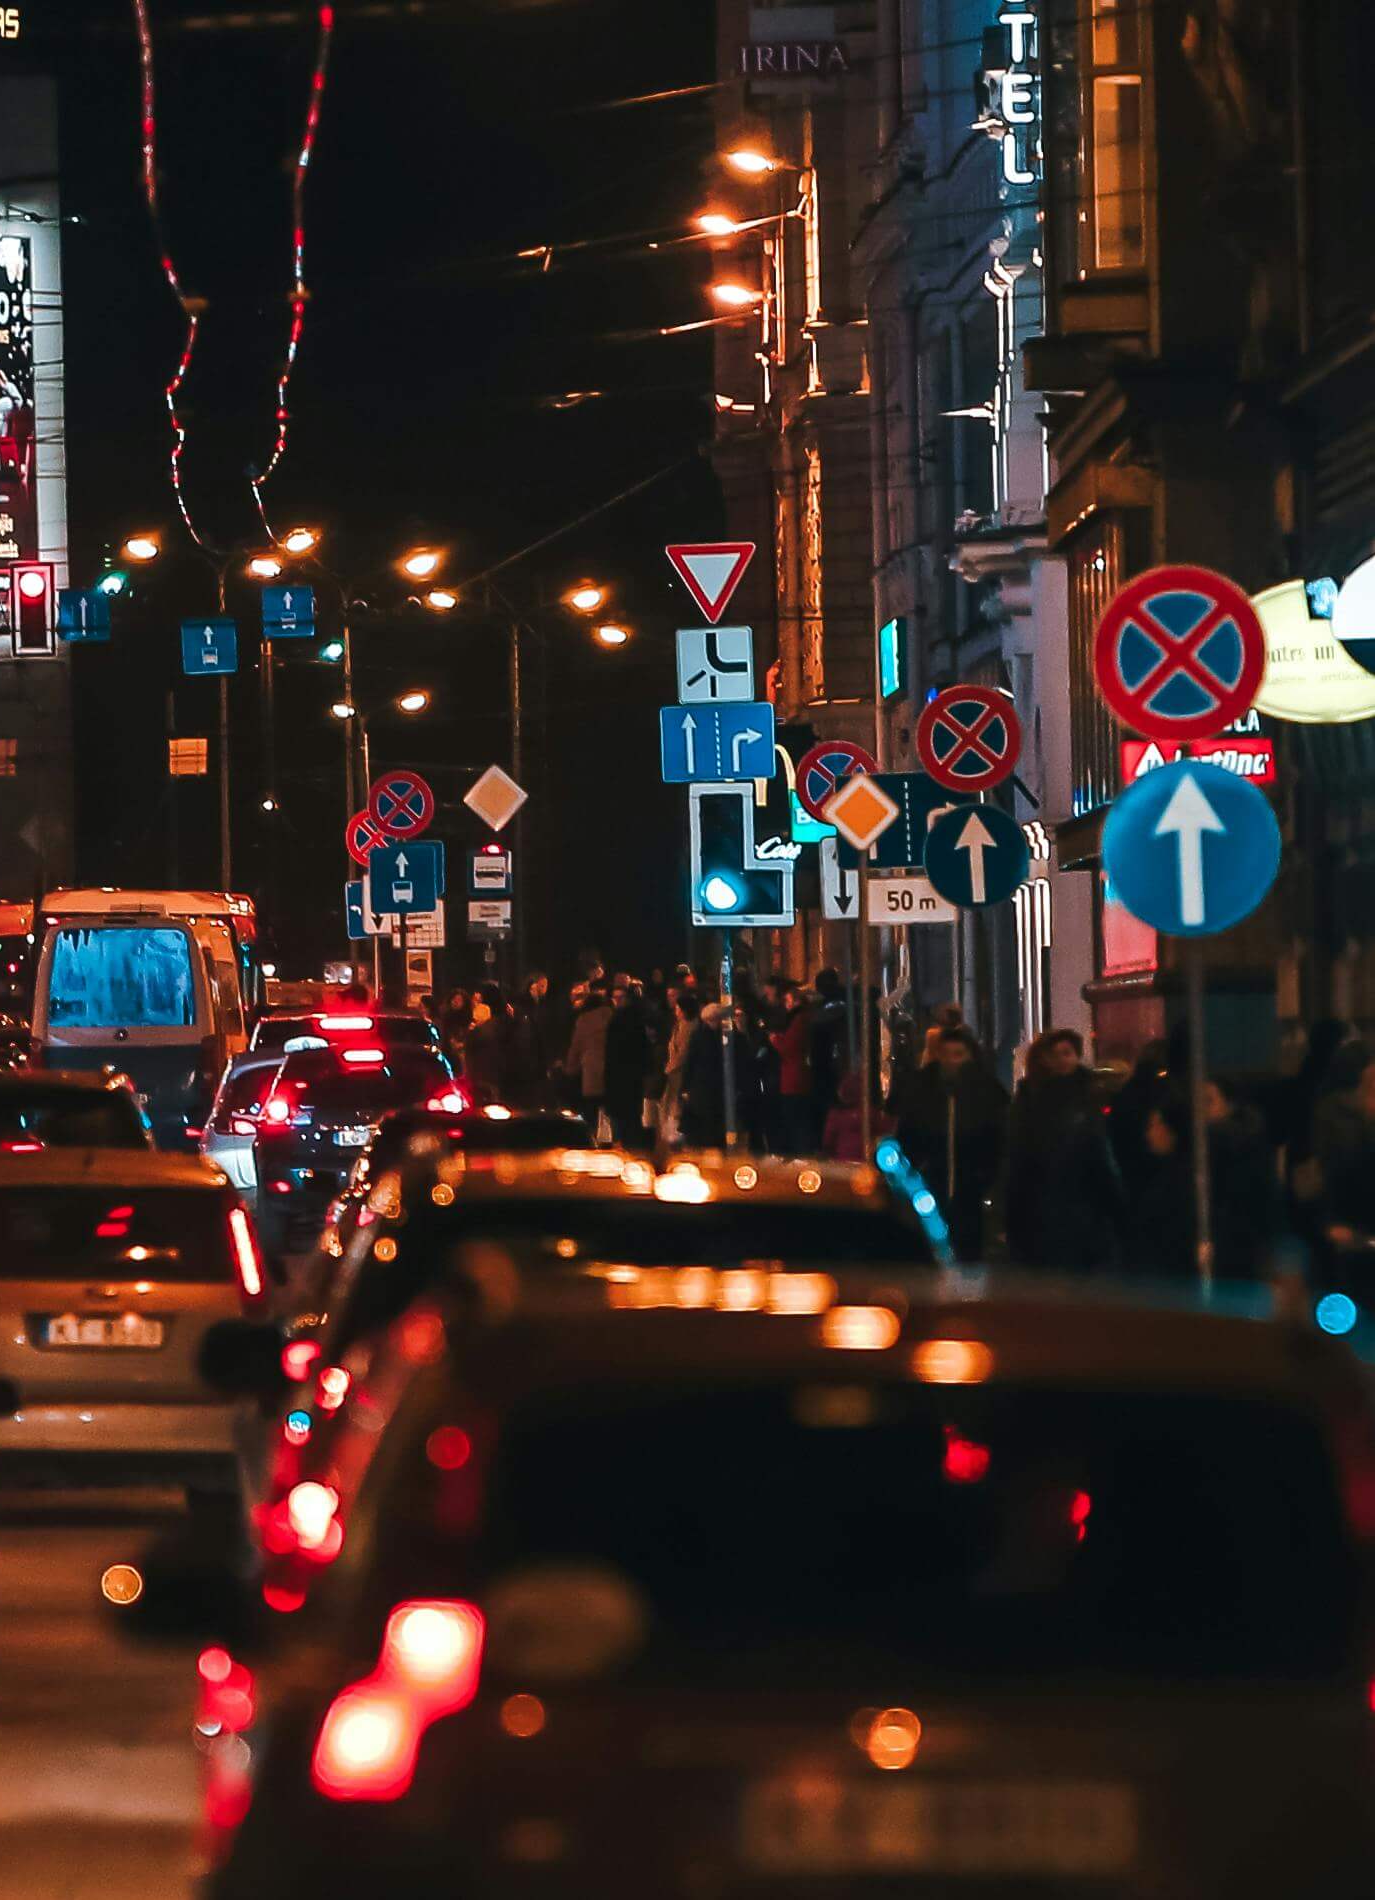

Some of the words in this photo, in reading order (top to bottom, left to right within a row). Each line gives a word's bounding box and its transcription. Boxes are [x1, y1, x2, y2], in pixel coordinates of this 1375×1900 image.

[739, 45, 849, 73] IRINA
[998, 0, 1036, 185] TEL
[886, 889, 914, 912] 50
[918, 897, 937, 911] m
